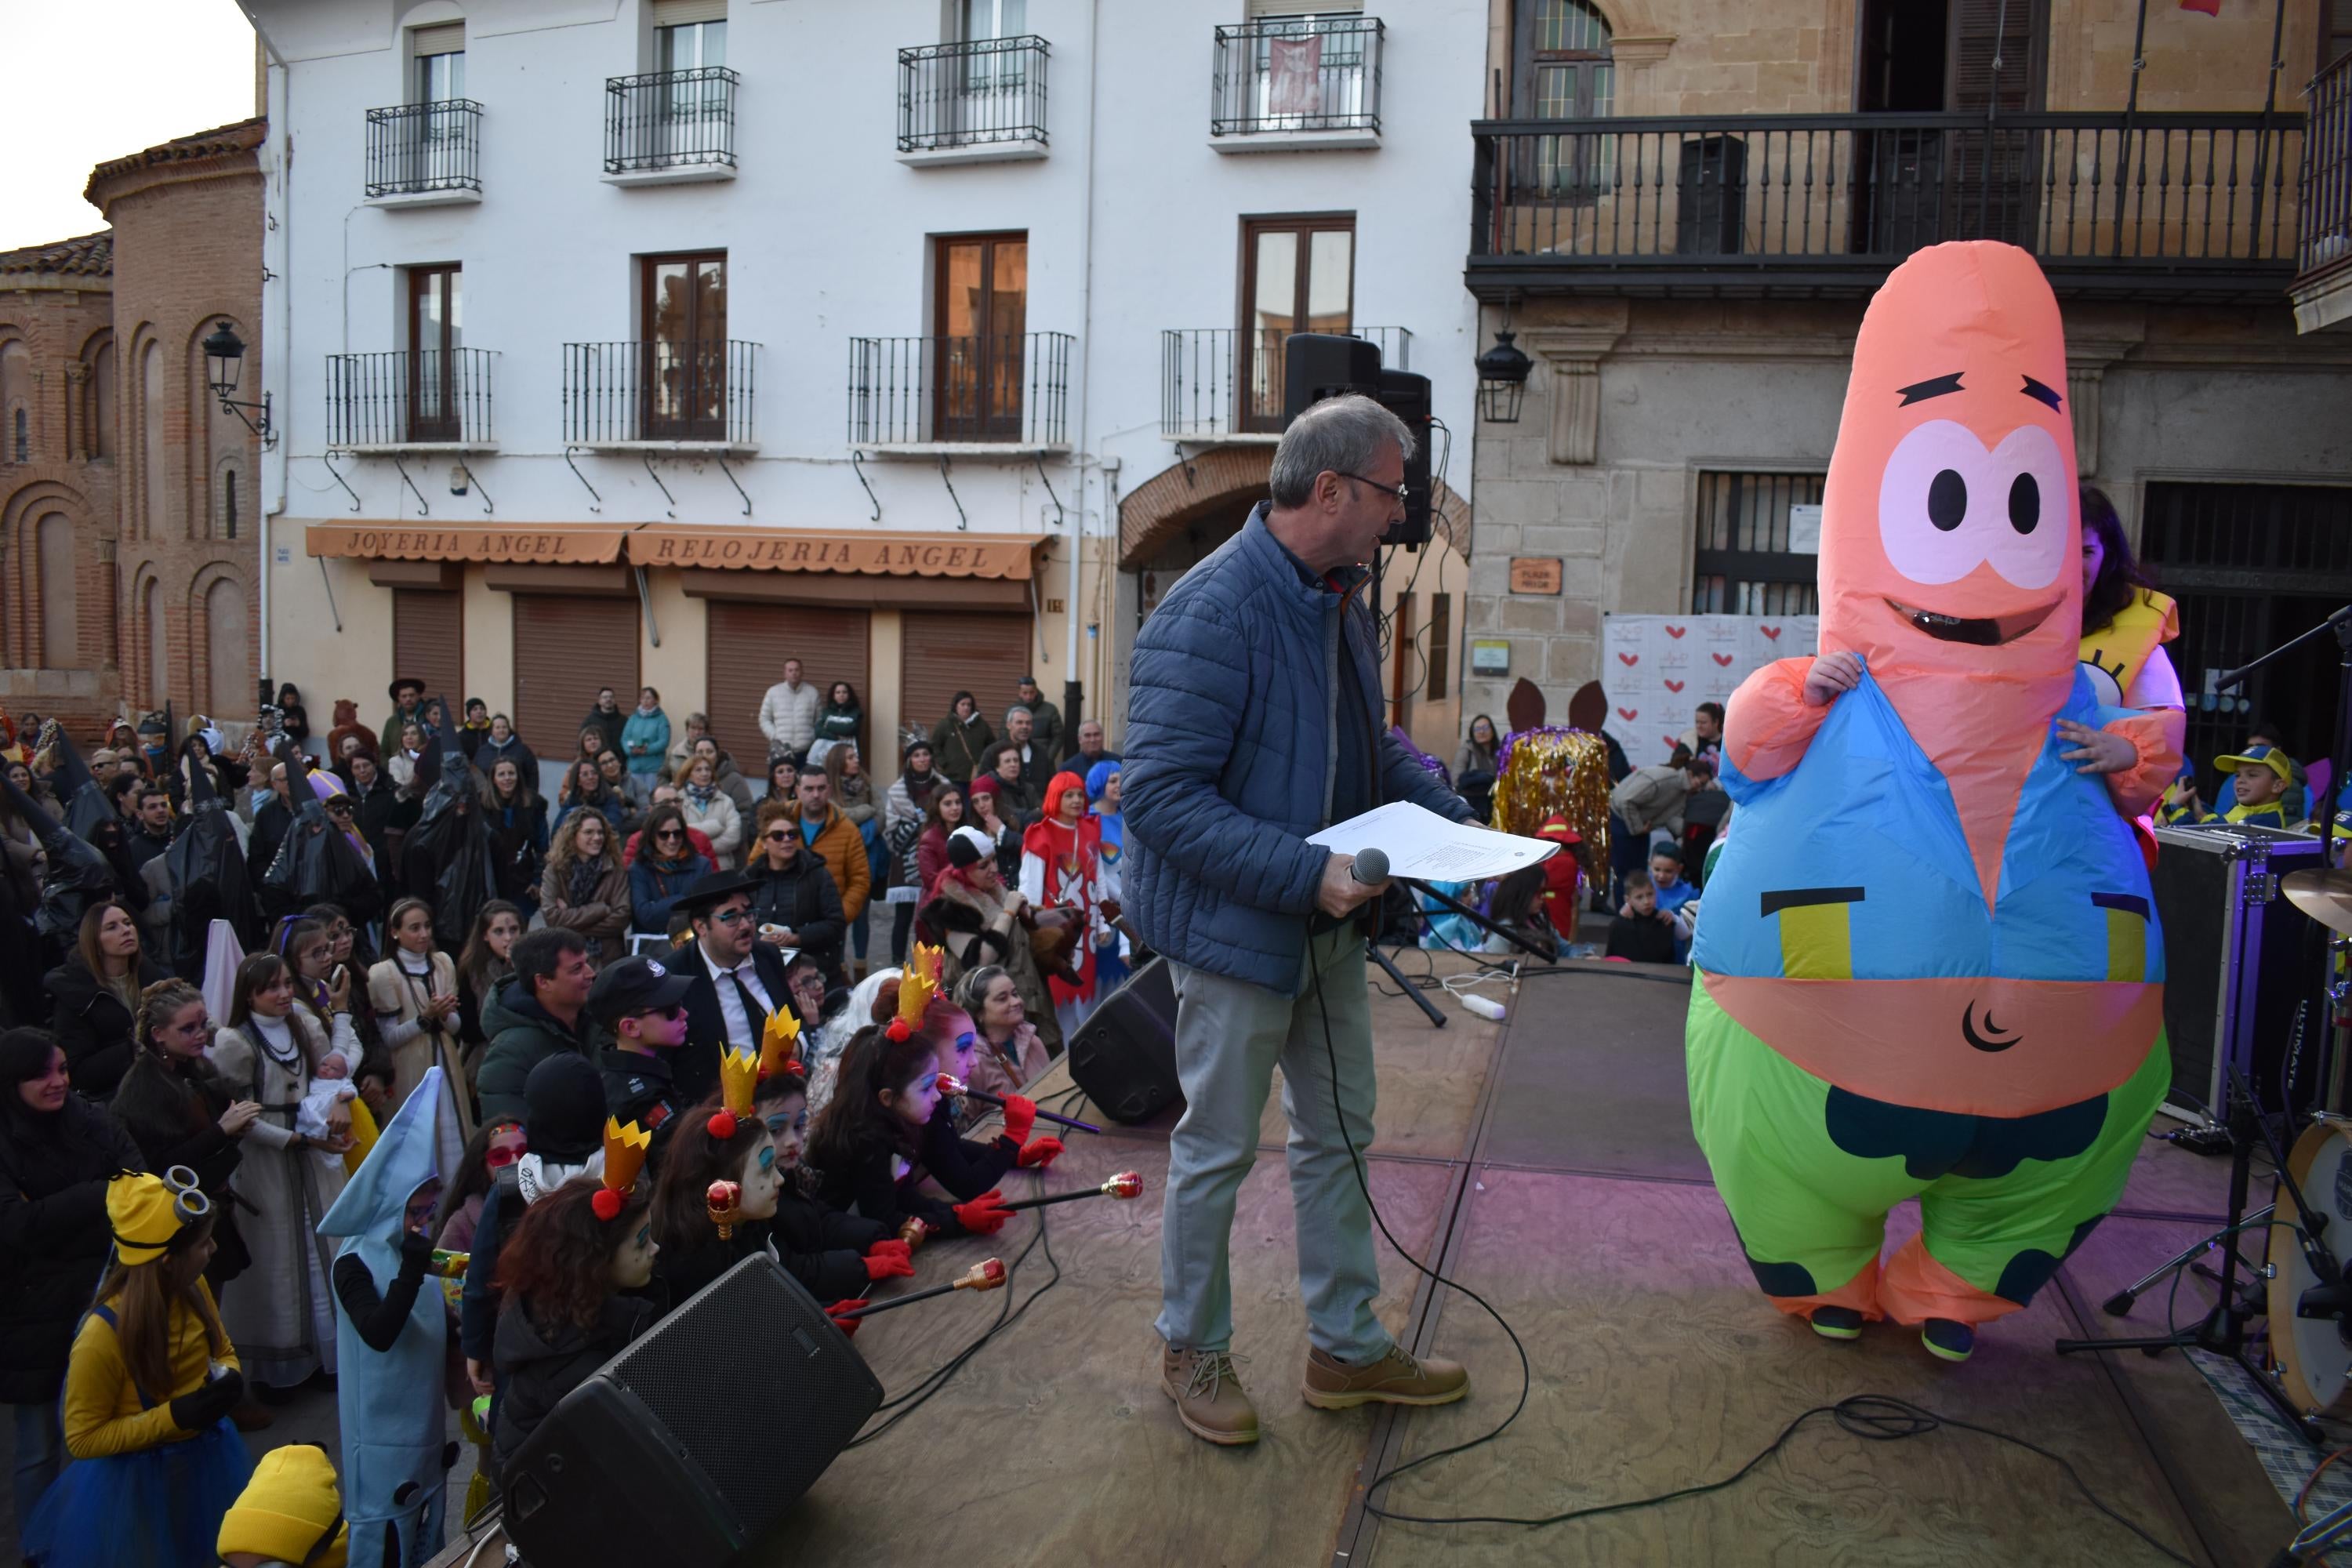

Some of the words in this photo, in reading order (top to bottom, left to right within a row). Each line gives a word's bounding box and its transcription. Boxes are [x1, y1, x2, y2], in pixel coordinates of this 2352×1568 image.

[347, 532, 459, 551] JOYERIA
[477, 535, 567, 554] ANGEL
[657, 539, 851, 563] RELOJERIA
[873, 545, 988, 568] ANGEL
[2287, 999, 2307, 1090] ULTIMATE
